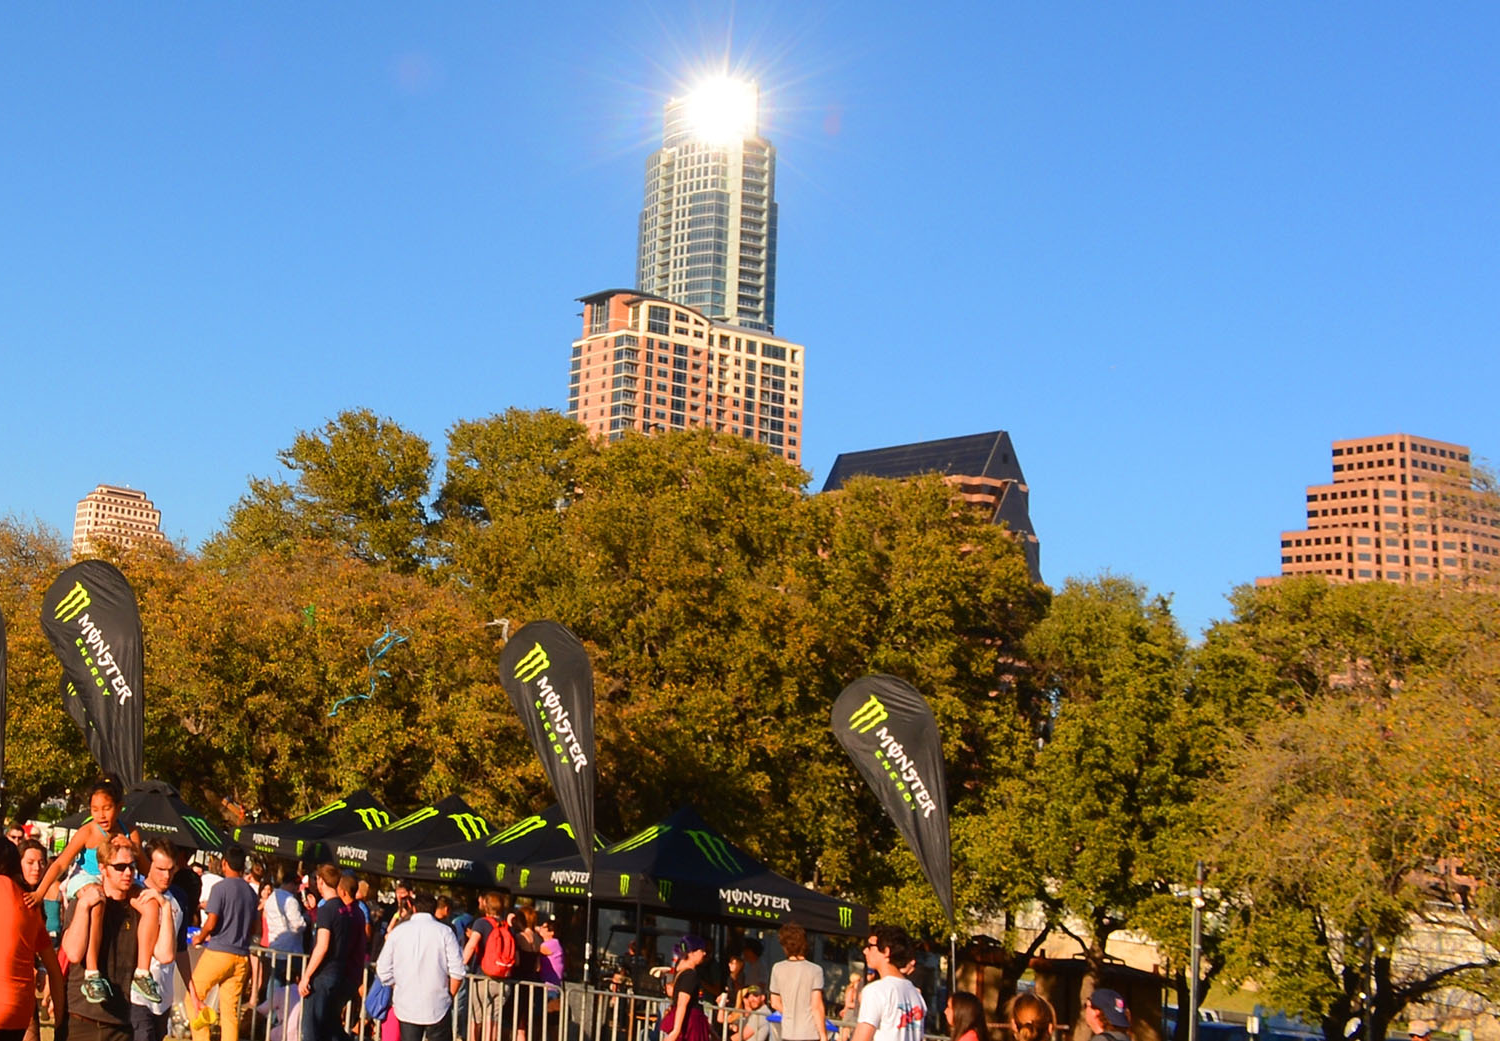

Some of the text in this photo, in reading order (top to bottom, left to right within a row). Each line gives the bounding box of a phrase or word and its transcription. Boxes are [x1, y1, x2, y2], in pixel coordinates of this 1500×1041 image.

[75, 637, 110, 696] ENERGY
[719, 888, 791, 912] MONSTER
[728, 906, 779, 919] ENERGY
